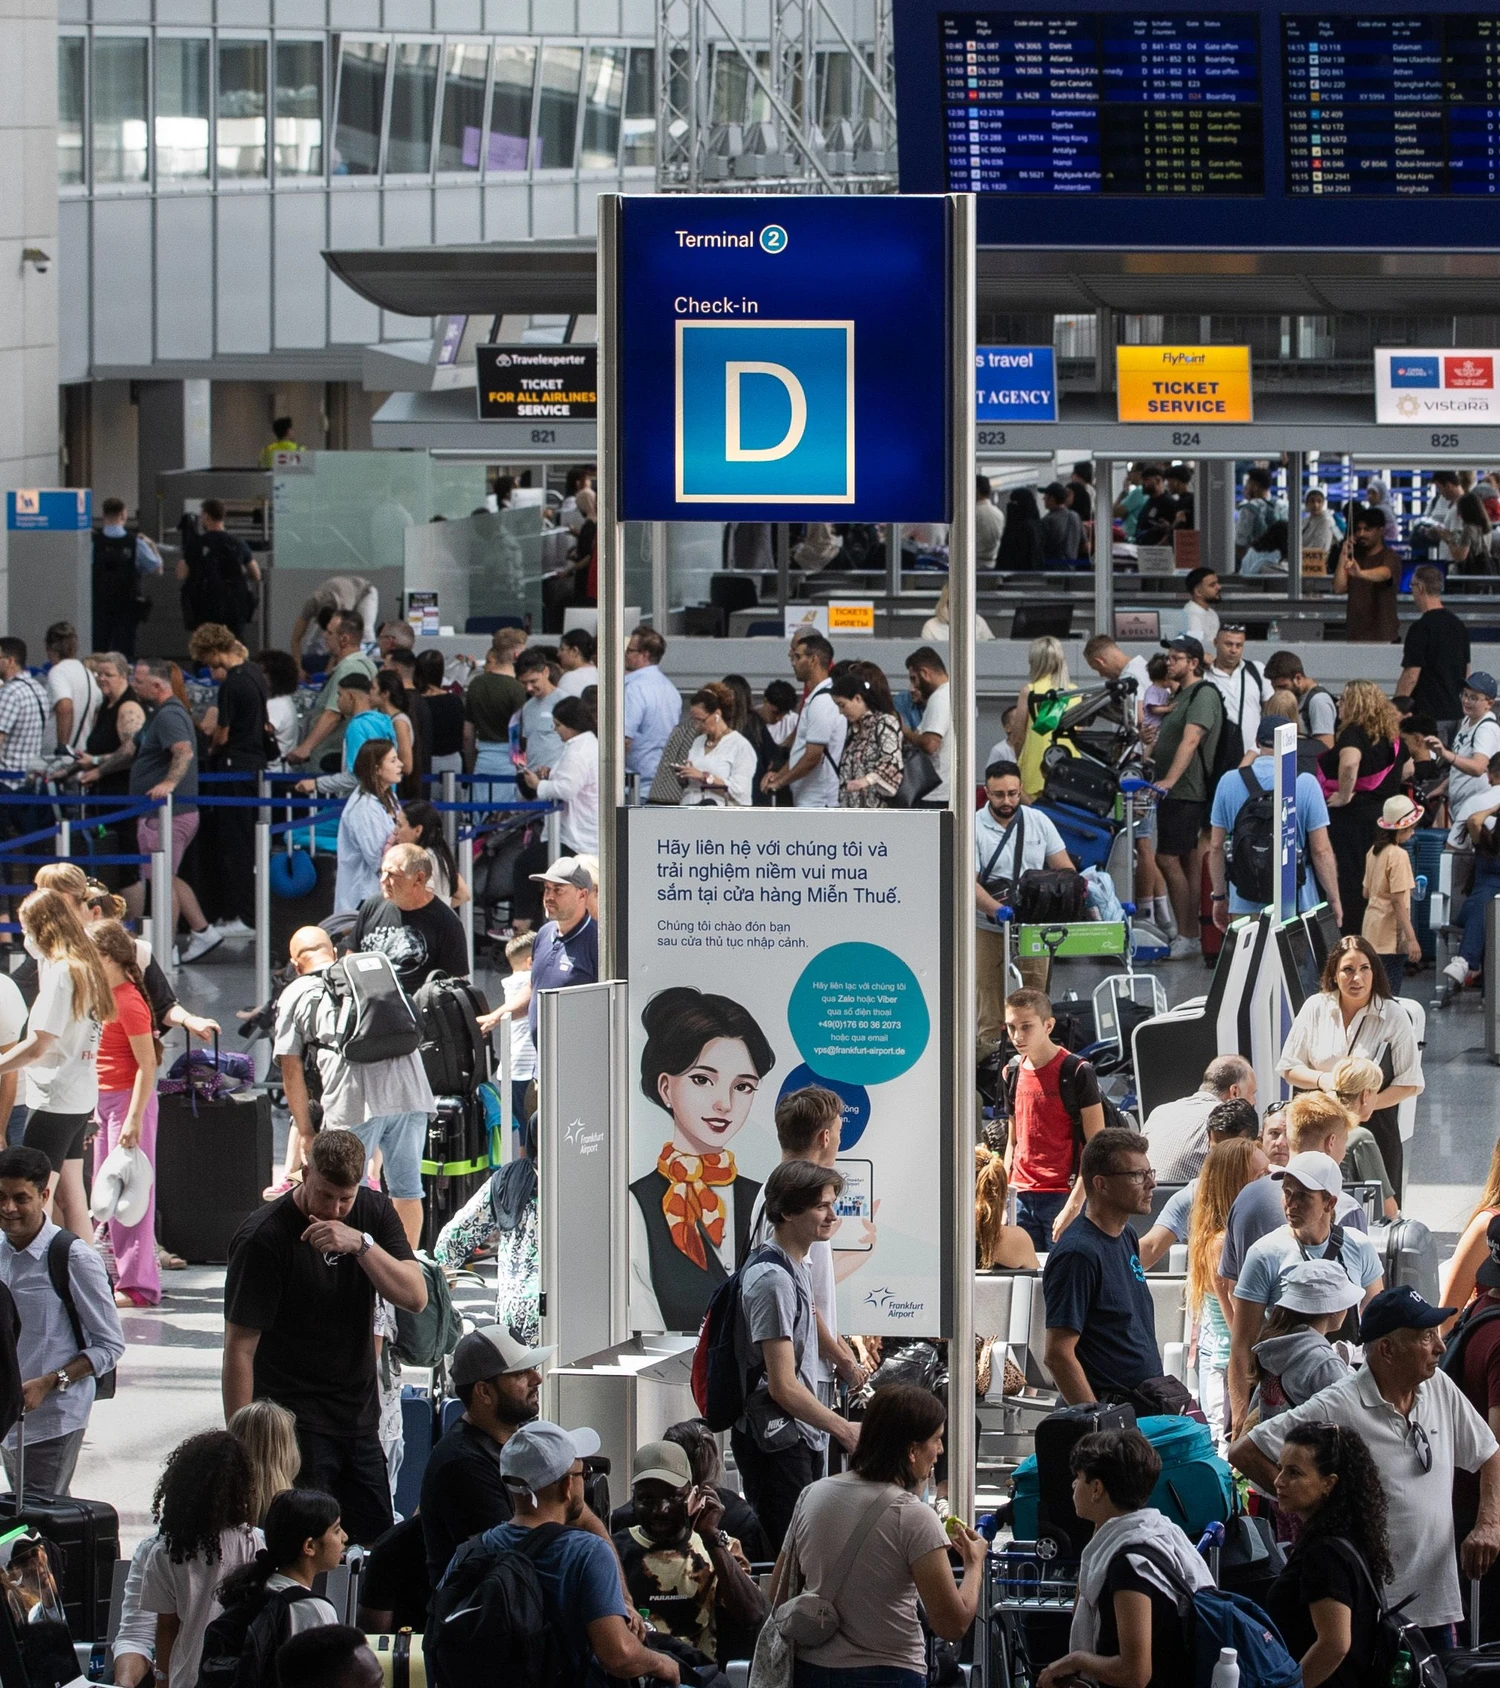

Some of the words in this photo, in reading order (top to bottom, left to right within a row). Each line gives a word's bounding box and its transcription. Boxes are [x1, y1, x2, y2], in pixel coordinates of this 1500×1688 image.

[1205, 56, 1235, 64] Boarding
[675, 231, 753, 247] Terminal
[766, 229, 779, 246] 2
[675, 297, 757, 313] Check-in
[509, 354, 585, 366] Travelexperter
[989, 352, 1033, 367] travel
[1163, 353, 1205, 365] FlyPoint
[521, 379, 563, 389] TICKET
[1153, 382, 1219, 394] TICKET
[489, 392, 514, 402] FOR
[517, 392, 539, 402] ALL
[542, 390, 598, 404] AIRLINES
[989, 391, 1050, 404] AGENCY
[518, 405, 570, 415] SERVICE
[726, 362, 807, 462] D
[1148, 400, 1225, 412] SERVICE
[531, 430, 555, 443] 821
[978, 431, 1006, 445] 823
[1173, 432, 1201, 445] 824
[1431, 434, 1459, 447] 825
[658, 839, 690, 858] Hãy
[697, 840, 724, 854] liên
[731, 840, 751, 859] hệ
[757, 840, 779, 855] với
[786, 841, 836, 860] chúng
[843, 841, 862, 856] tôi
[868, 842, 887, 856] và
[657, 862, 682, 877] trải
[689, 863, 749, 882] nghiệm
[756, 862, 795, 879] niềm
[802, 864, 825, 879] vui
[832, 868, 867, 879] mua
[658, 883, 692, 900] sắm
[698, 886, 717, 905] tại
[724, 886, 754, 901] cửa
[761, 887, 801, 906] hàng
[808, 884, 847, 902] Miễn
[853, 887, 900, 903] Thuế.
[658, 920, 694, 933] Chúng
[698, 921, 710, 931] tôi
[715, 921, 741, 931] chào
[745, 921, 766, 931] đón
[770, 922, 790, 934] bạn
[658, 938, 677, 946] sau
[681, 936, 702, 946] cửa
[706, 936, 722, 946] thủ
[727, 938, 743, 949] tục
[747, 937, 774, 949] nhập
[778, 937, 808, 947] cảnh.
[819, 1020, 857, 1029] +49(0)176
[882, 1021, 901, 1029] 2073
[581, 1133, 604, 1145] Frankfurt
[580, 1143, 598, 1155] Airport
[889, 1302, 924, 1311] Frankfurt
[888, 1310, 915, 1318] Airport
[767, 1418, 785, 1430] NIKE
